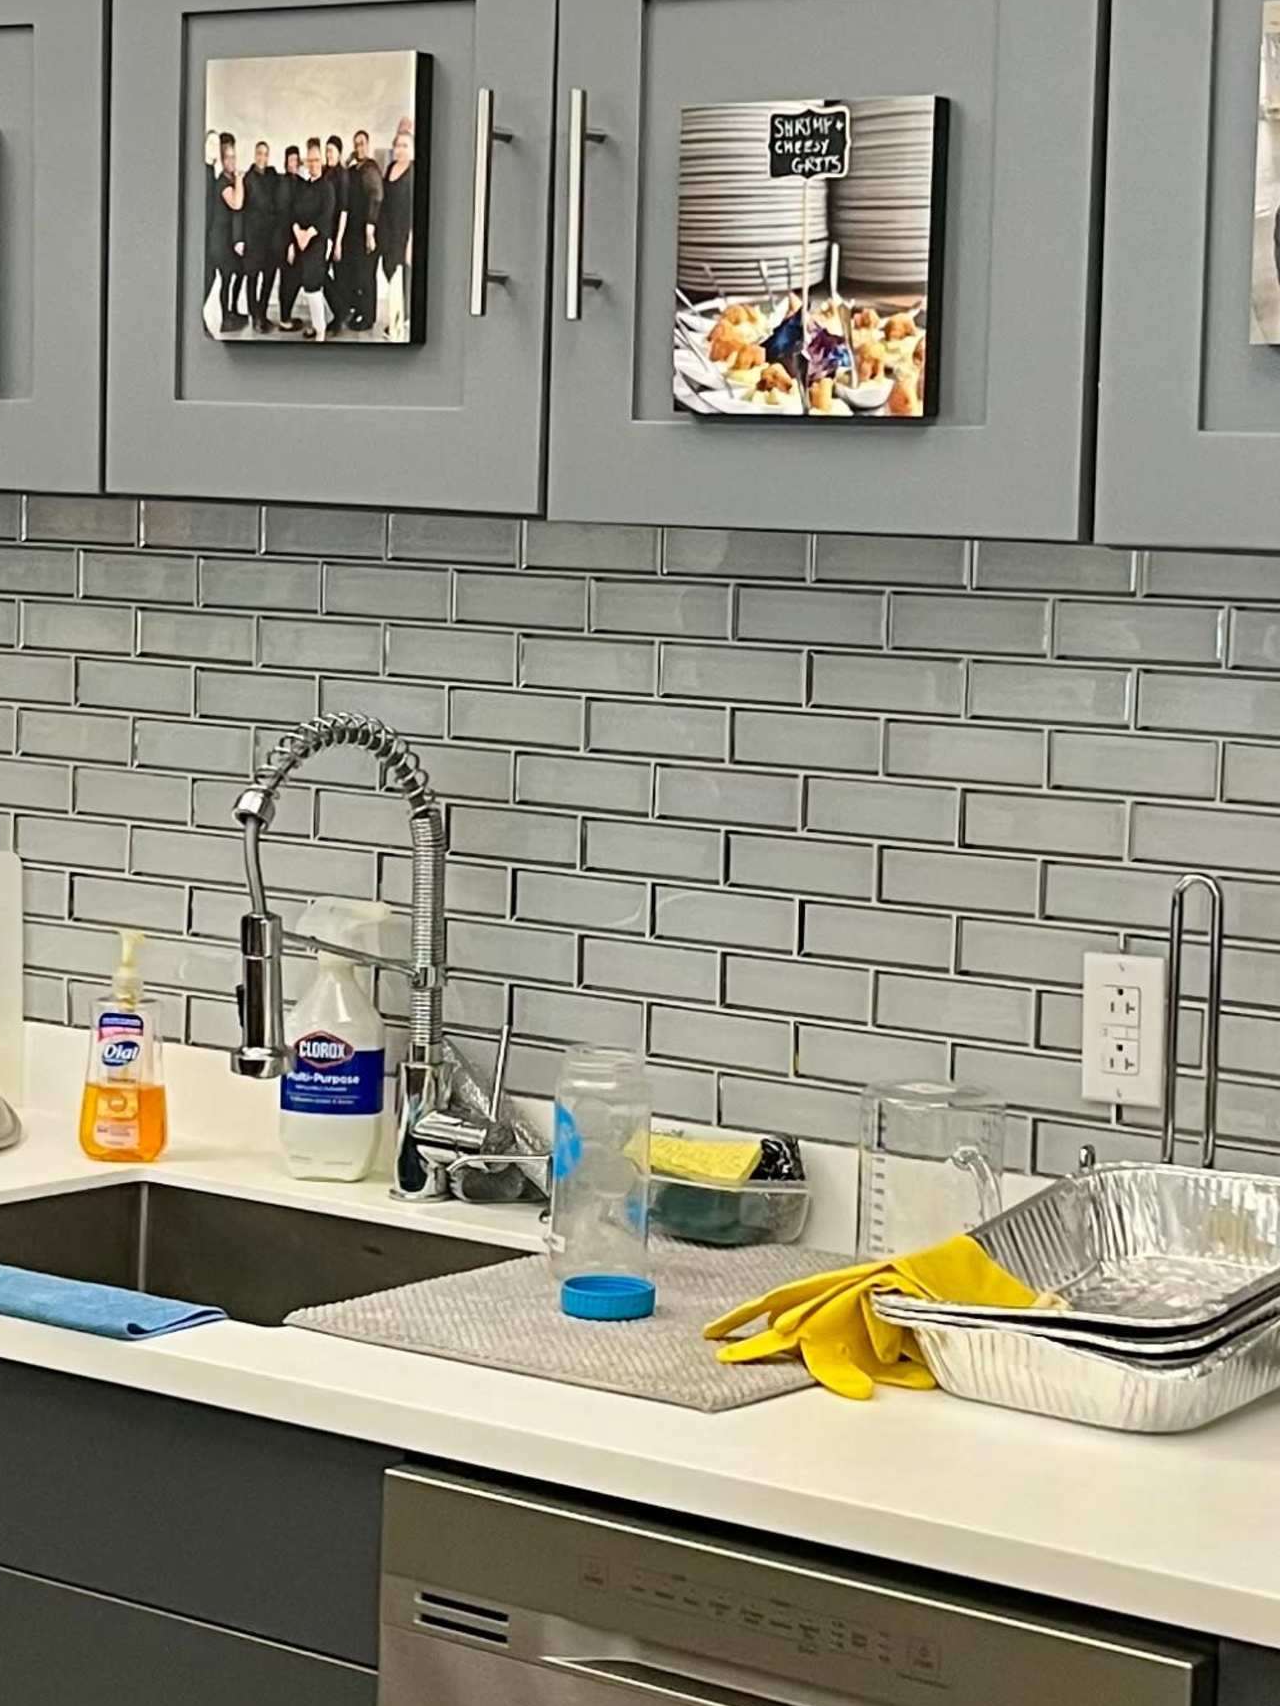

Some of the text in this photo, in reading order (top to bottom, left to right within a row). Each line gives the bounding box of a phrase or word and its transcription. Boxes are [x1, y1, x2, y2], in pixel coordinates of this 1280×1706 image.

[773, 116, 833, 139] SHRIMP
[791, 155, 842, 174] GRITS
[103, 1043, 140, 1062] Dial
[299, 1040, 347, 1060] CLOROX
